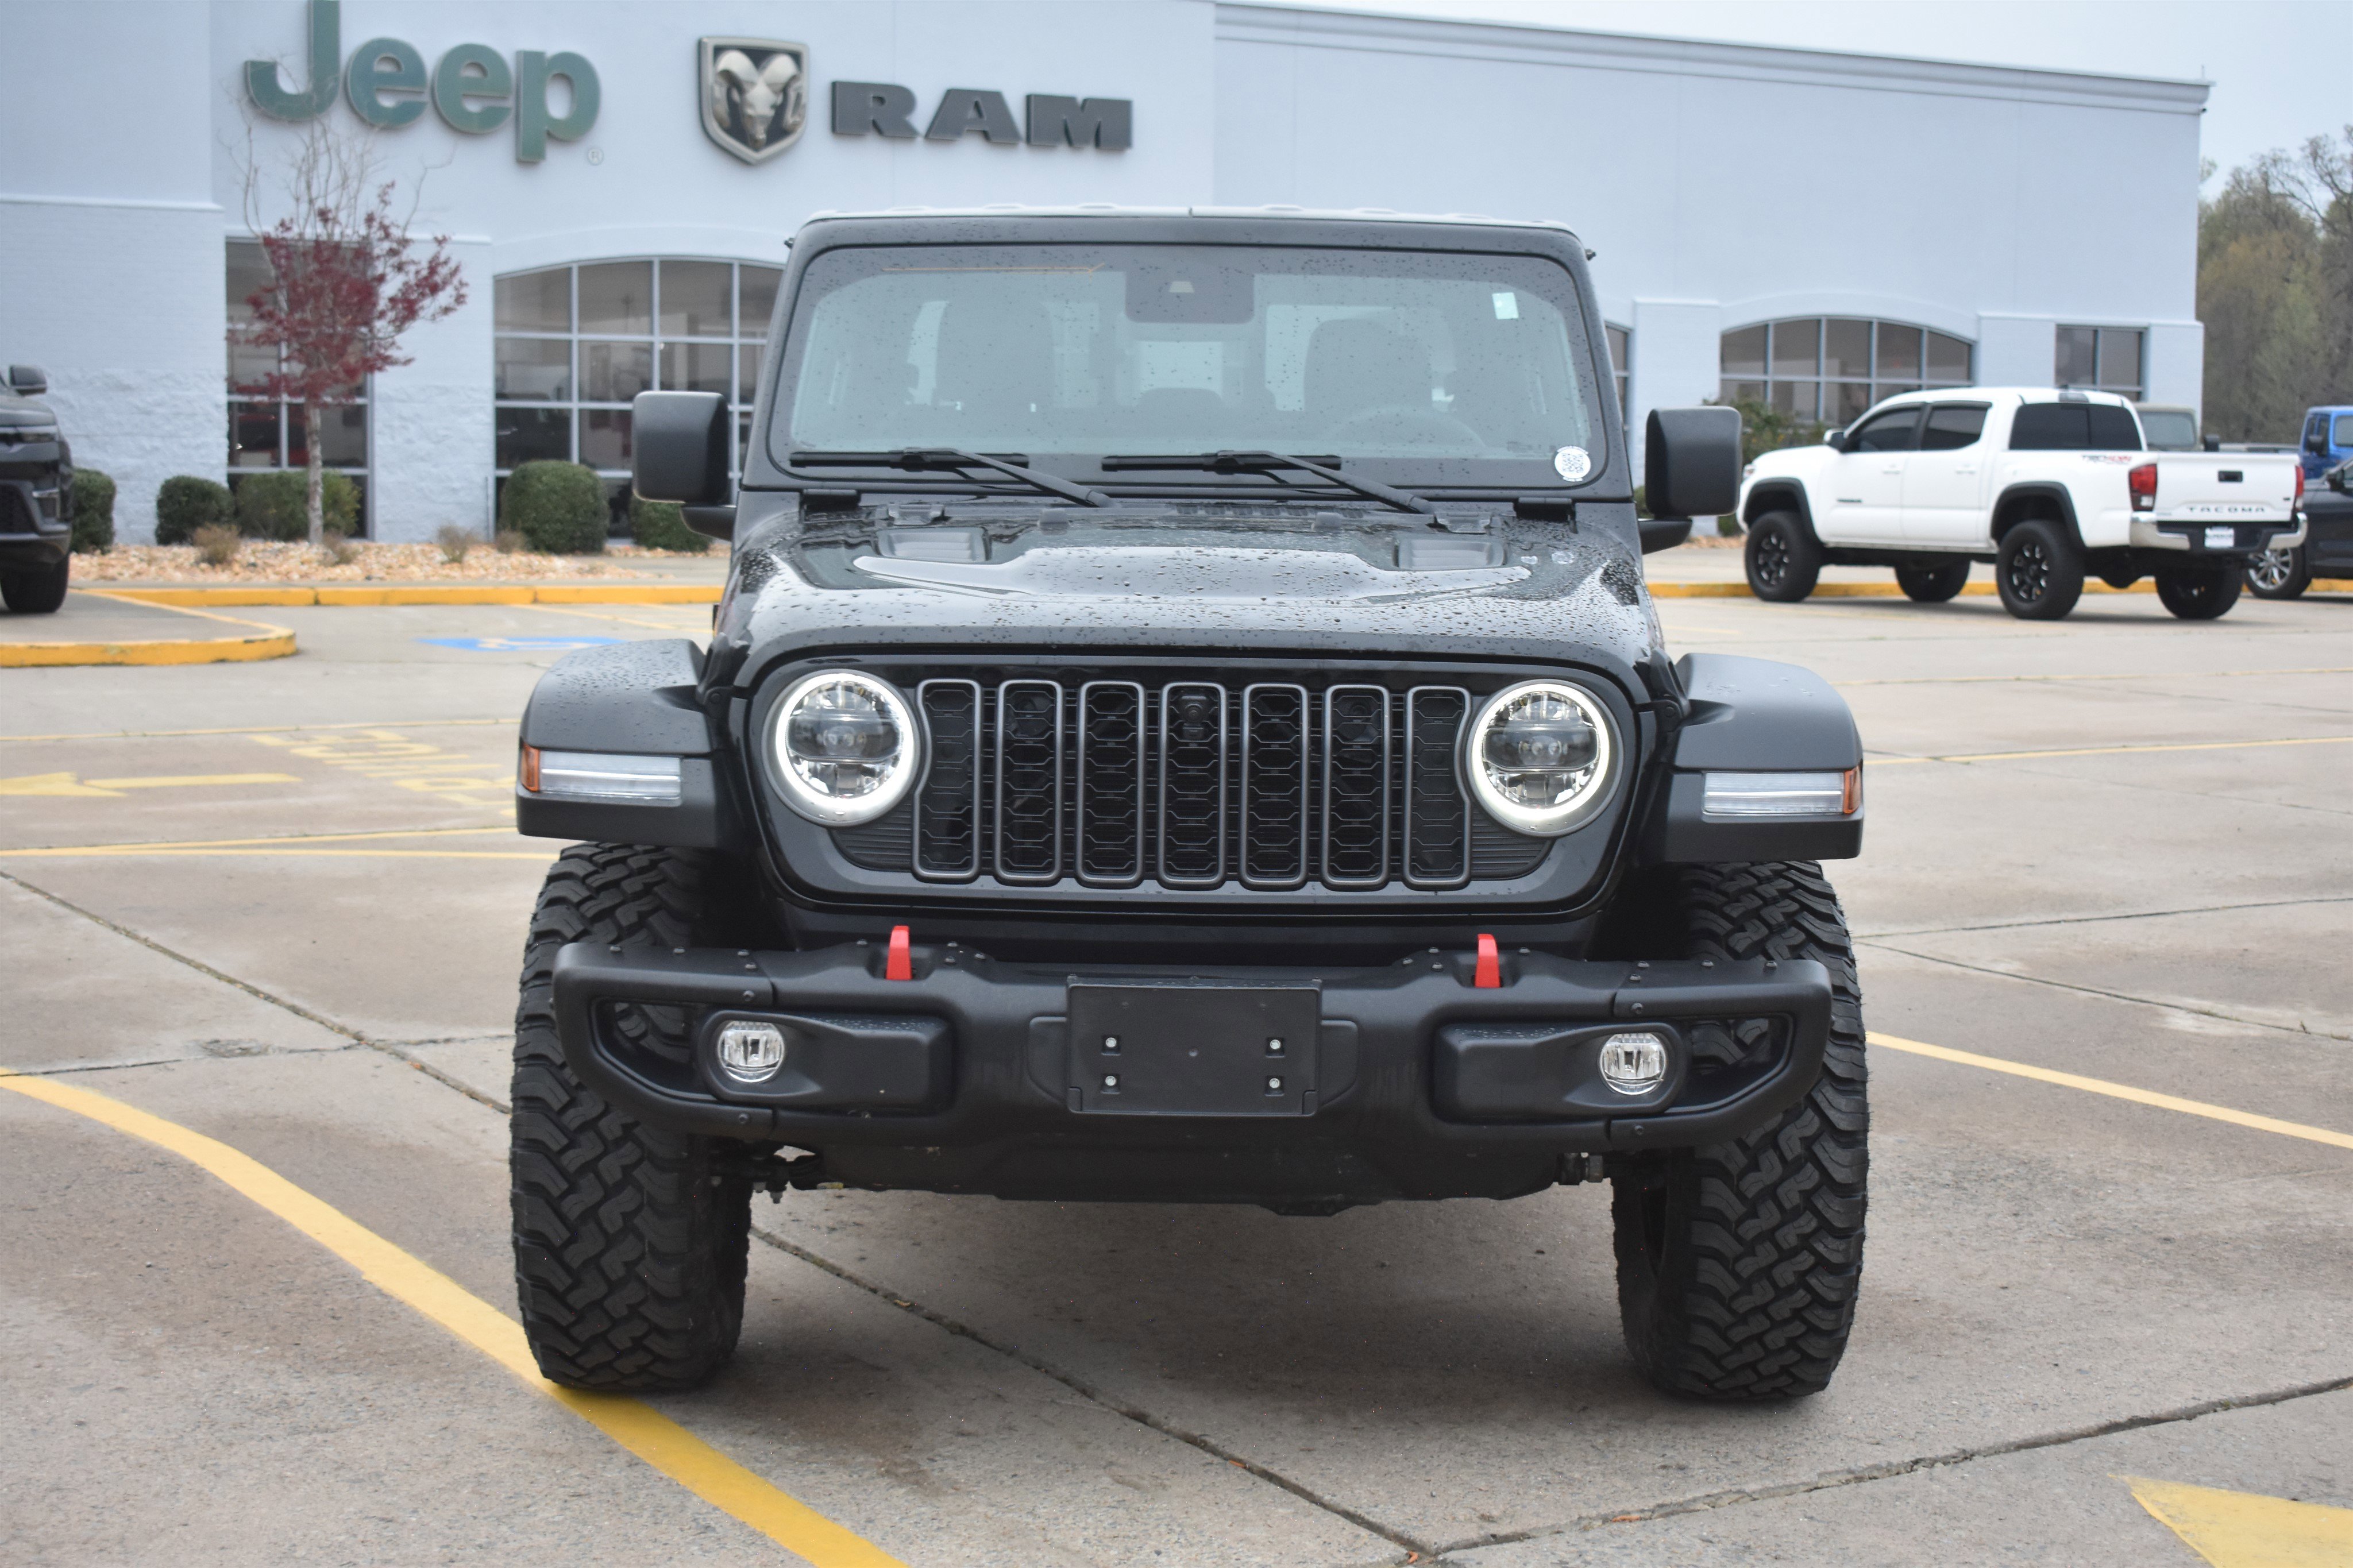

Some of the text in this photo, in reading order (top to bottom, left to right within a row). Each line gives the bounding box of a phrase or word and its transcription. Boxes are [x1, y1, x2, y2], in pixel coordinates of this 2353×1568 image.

[244, 0, 601, 163] Jeep
[831, 80, 1133, 150] RAM
[247, 729, 516, 818] RVICE
